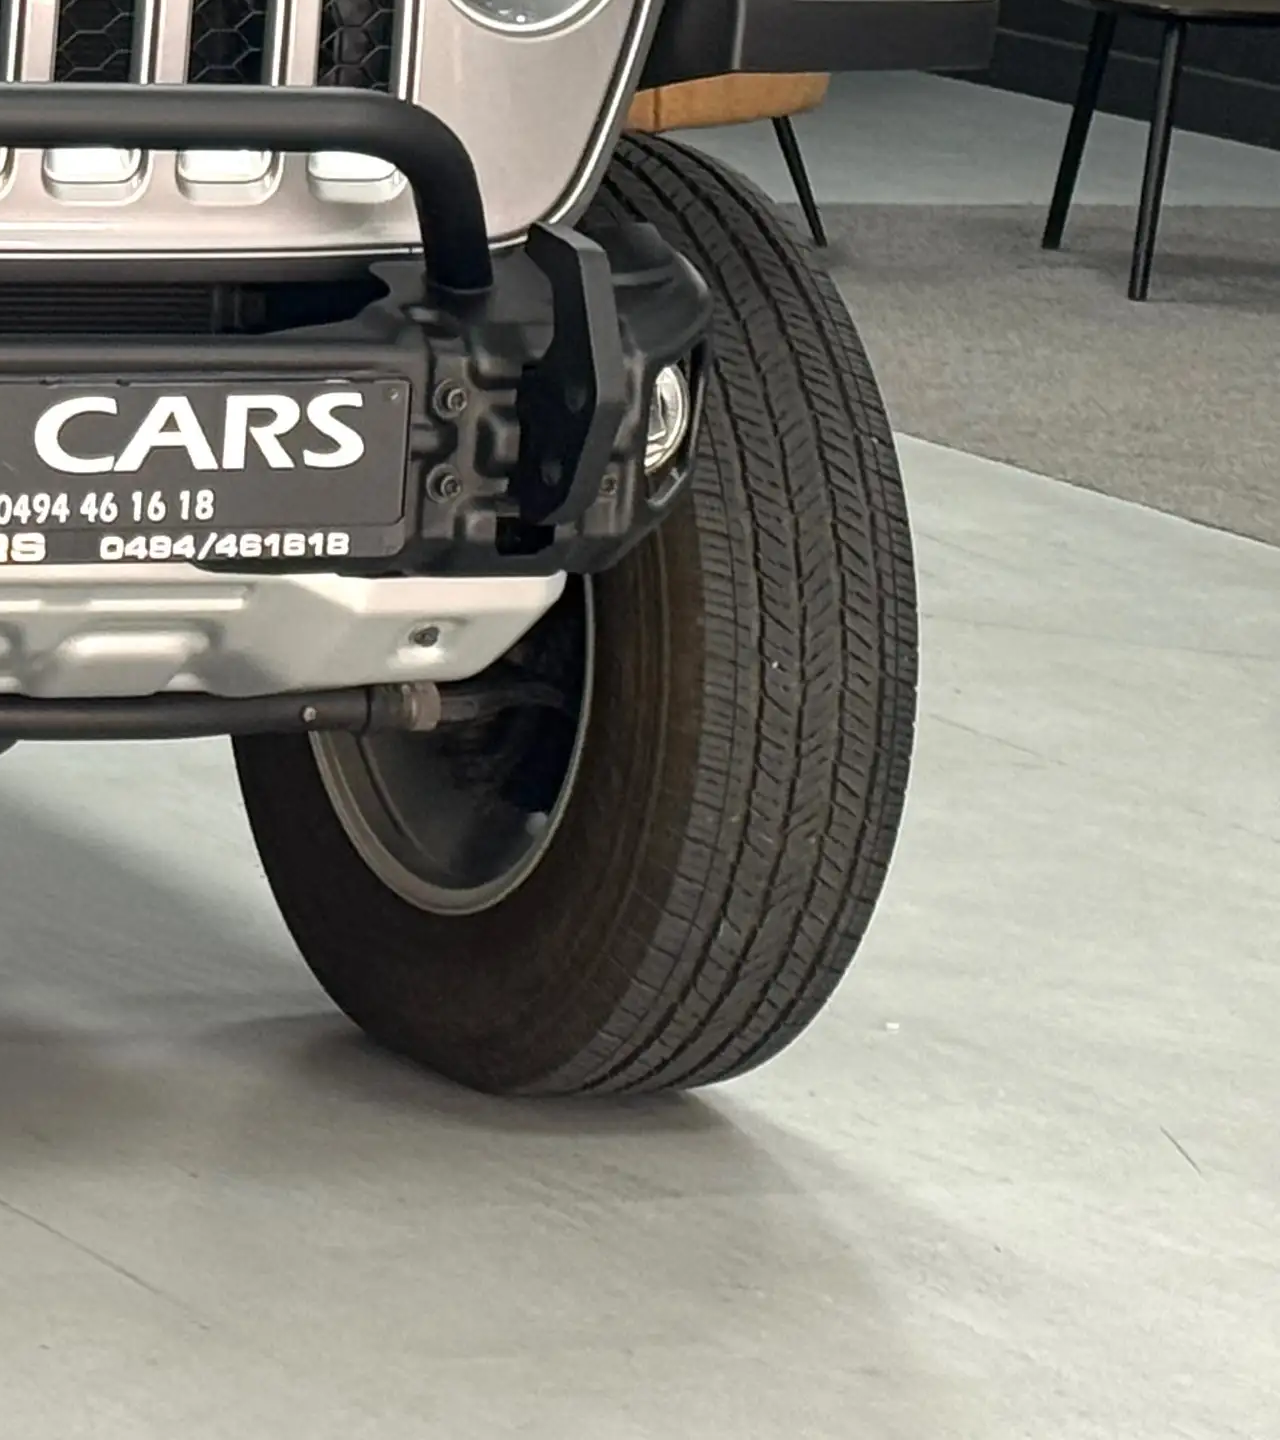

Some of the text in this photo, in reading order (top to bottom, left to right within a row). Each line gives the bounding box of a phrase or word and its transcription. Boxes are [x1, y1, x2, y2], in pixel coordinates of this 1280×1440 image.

[33, 391, 366, 475] CARS
[79, 491, 119, 523] 46
[131, 490, 167, 522] 16
[179, 488, 215, 521] 18
